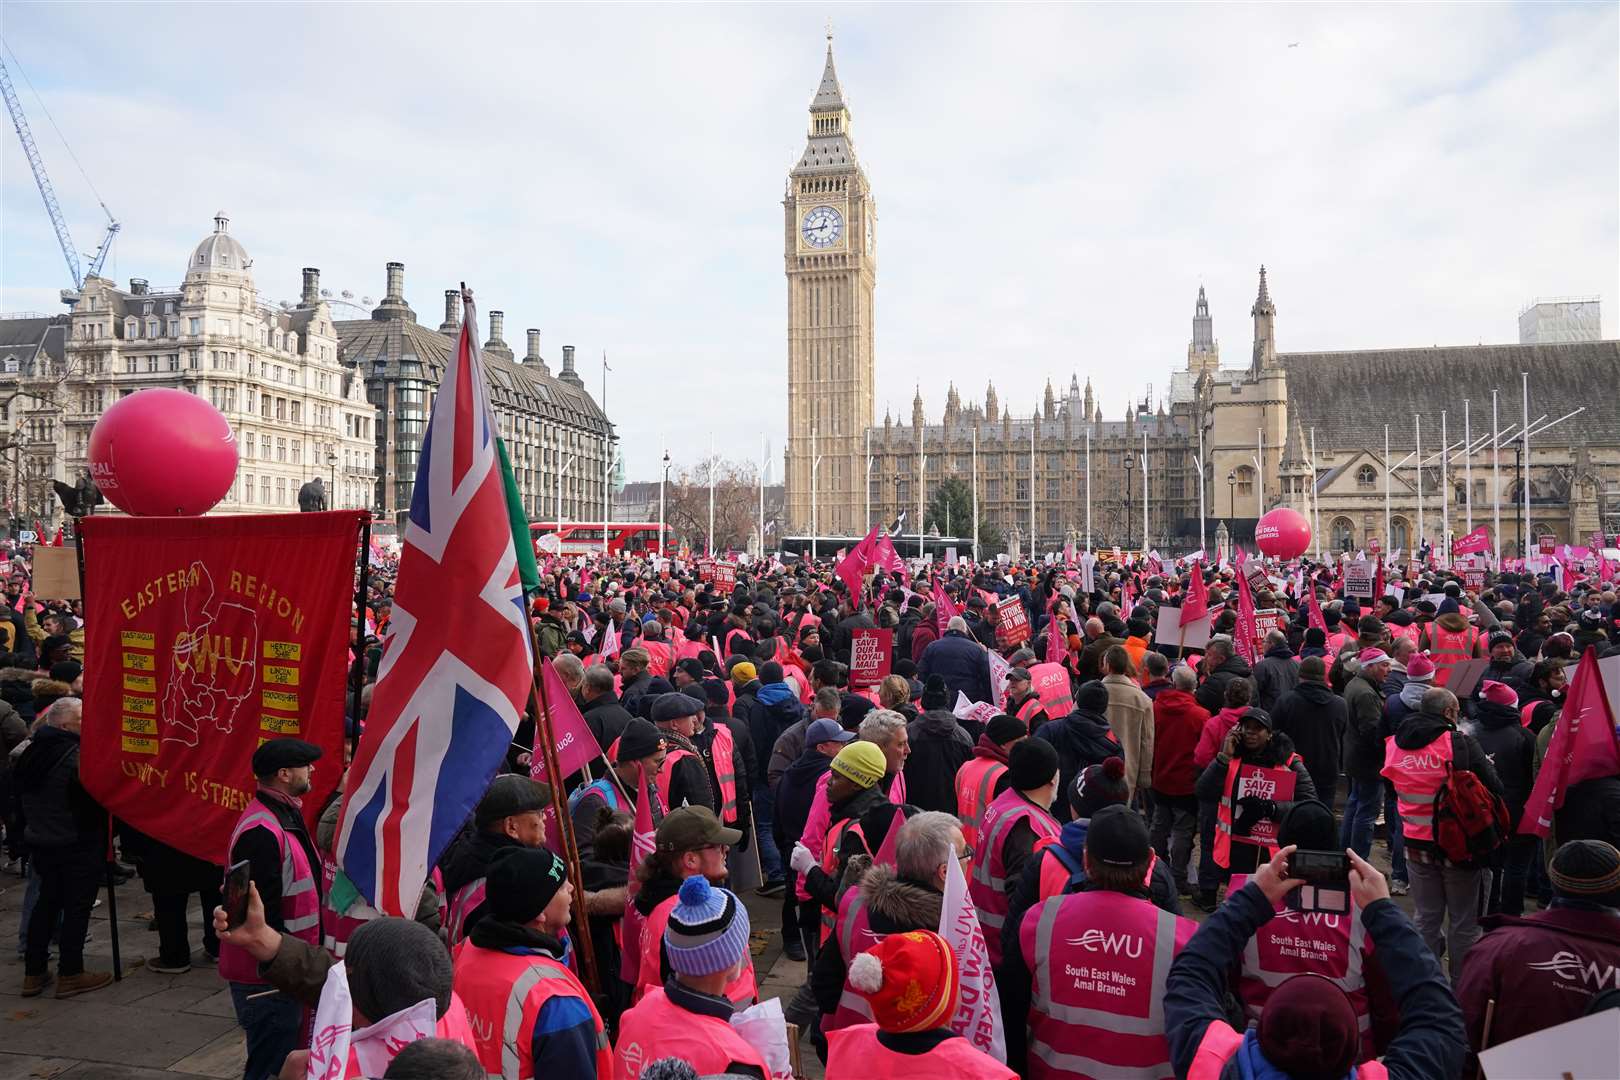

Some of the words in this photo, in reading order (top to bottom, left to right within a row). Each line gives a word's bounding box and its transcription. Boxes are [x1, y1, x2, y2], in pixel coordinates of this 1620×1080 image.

[716, 574, 723, 582] TO
[724, 574, 734, 582] WIN
[120, 567, 201, 619] EASTERN
[230, 570, 305, 635] REGION
[1000, 603, 1023, 620] STRIKE
[1002, 618, 1014, 631] TO
[1012, 612, 1027, 627] WIN
[1255, 617, 1278, 629] STRIKE
[1256, 628, 1265, 639] TO
[855, 638, 877, 647] SAVE
[855, 646, 874, 654] OUR
[855, 653, 882, 662] ROYAL
[855, 660, 877, 669] MAIL
[1040, 671, 1063, 686] CWU
[1391, 752, 1441, 769] CWU
[184, 771, 197, 793] IS
[1244, 779, 1273, 792] SAVE
[1064, 929, 1143, 958] CWU
[1271, 934, 1293, 946] South
[1294, 936, 1311, 948] East
[1312, 939, 1337, 952] Wales
[1279, 946, 1299, 957] Amal
[1300, 949, 1328, 961] Branch
[1065, 964, 1089, 978] South
[1091, 968, 1110, 981] East
[1111, 971, 1137, 986] Wales
[1073, 977, 1095, 990] Amal
[1097, 981, 1126, 996] Branch
[465, 1008, 493, 1041] WU
